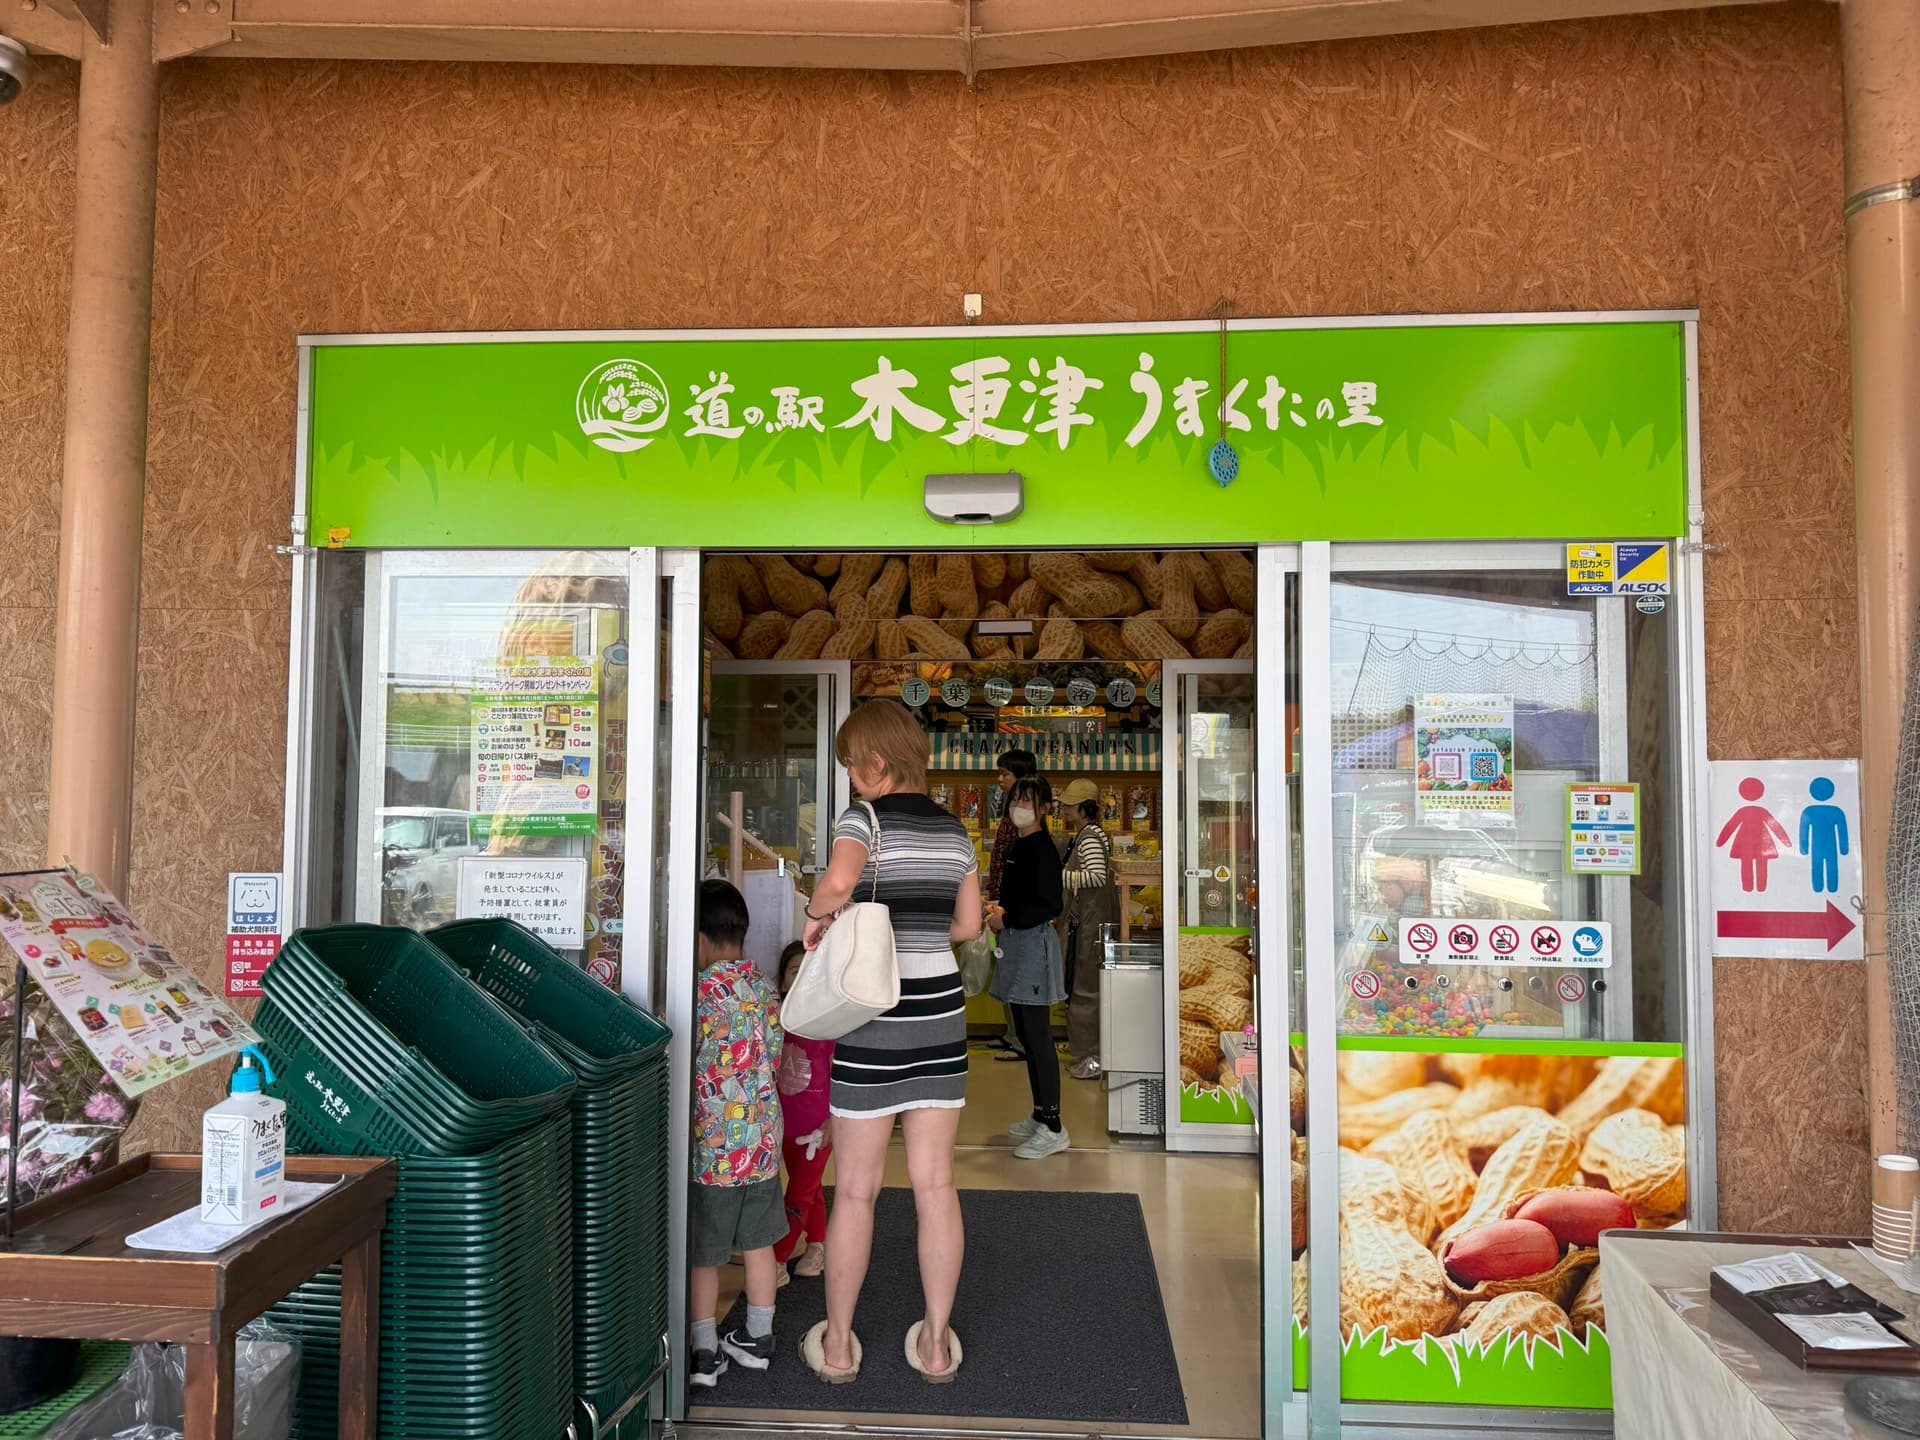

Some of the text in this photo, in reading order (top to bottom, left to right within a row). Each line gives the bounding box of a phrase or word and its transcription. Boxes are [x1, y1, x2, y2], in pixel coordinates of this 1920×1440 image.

[683, 352, 1384, 451] 道の駅 木更津 うまくたの里
[1570, 560, 1611, 569] 防犯カメラ
[1578, 571, 1604, 580] 作動中
[1618, 583, 1667, 592] ALSOK
[950, 738, 1136, 755] CRAZY PEANUTS
[528, 926, 577, 935] 願い致します。
